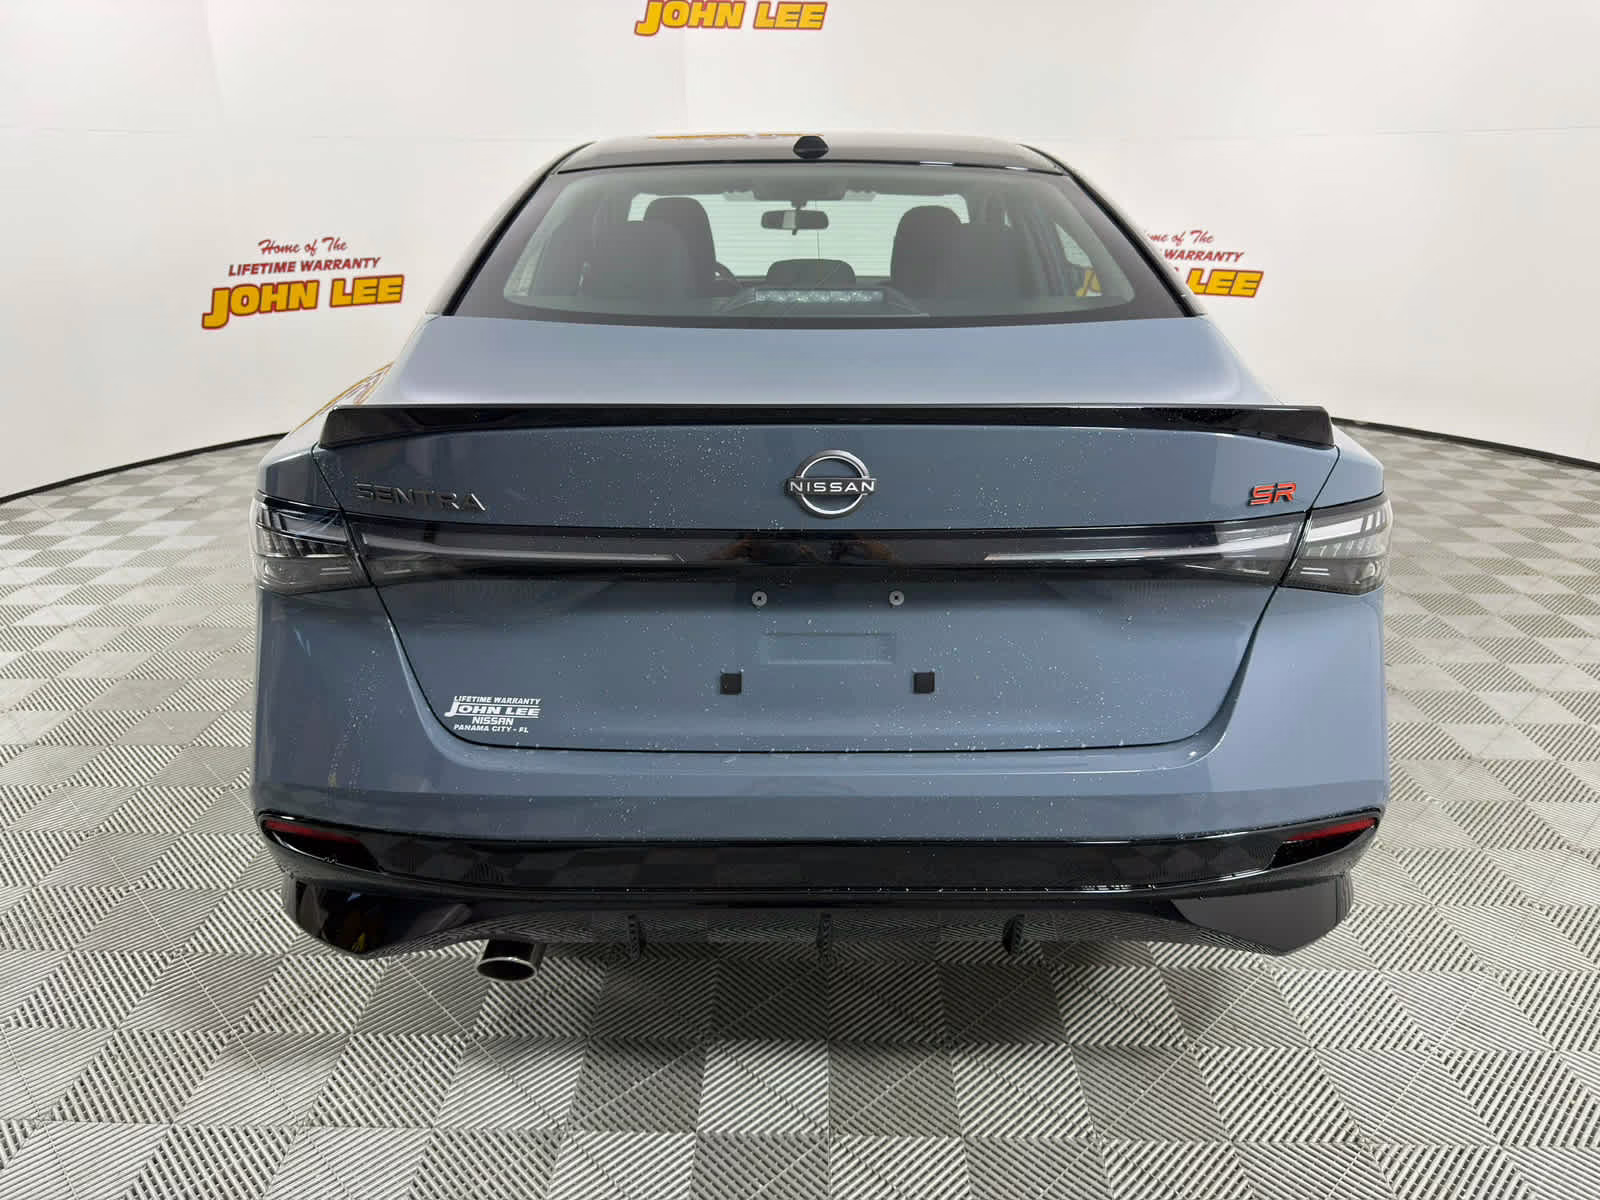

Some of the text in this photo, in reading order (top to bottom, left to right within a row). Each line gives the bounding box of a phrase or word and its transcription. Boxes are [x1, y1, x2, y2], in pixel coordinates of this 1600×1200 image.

[634, 0, 828, 36] JOHN LEE
[258, 236, 347, 256] Home of The
[1171, 231, 1186, 246] of
[1190, 229, 1214, 244] The
[1163, 249, 1244, 263] WARRANTY
[228, 257, 381, 277] LIFETIME WARRANTY
[1186, 268, 1264, 298] LEE
[201, 274, 404, 329] JOHN LEE
[353, 481, 486, 512] SENTRA
[790, 481, 875, 492] NISSAN
[1249, 482, 1296, 505] SR
[444, 701, 541, 717] JOHN LEE
[453, 724, 490, 732] PANAMA
[472, 716, 514, 726] NISSAN
